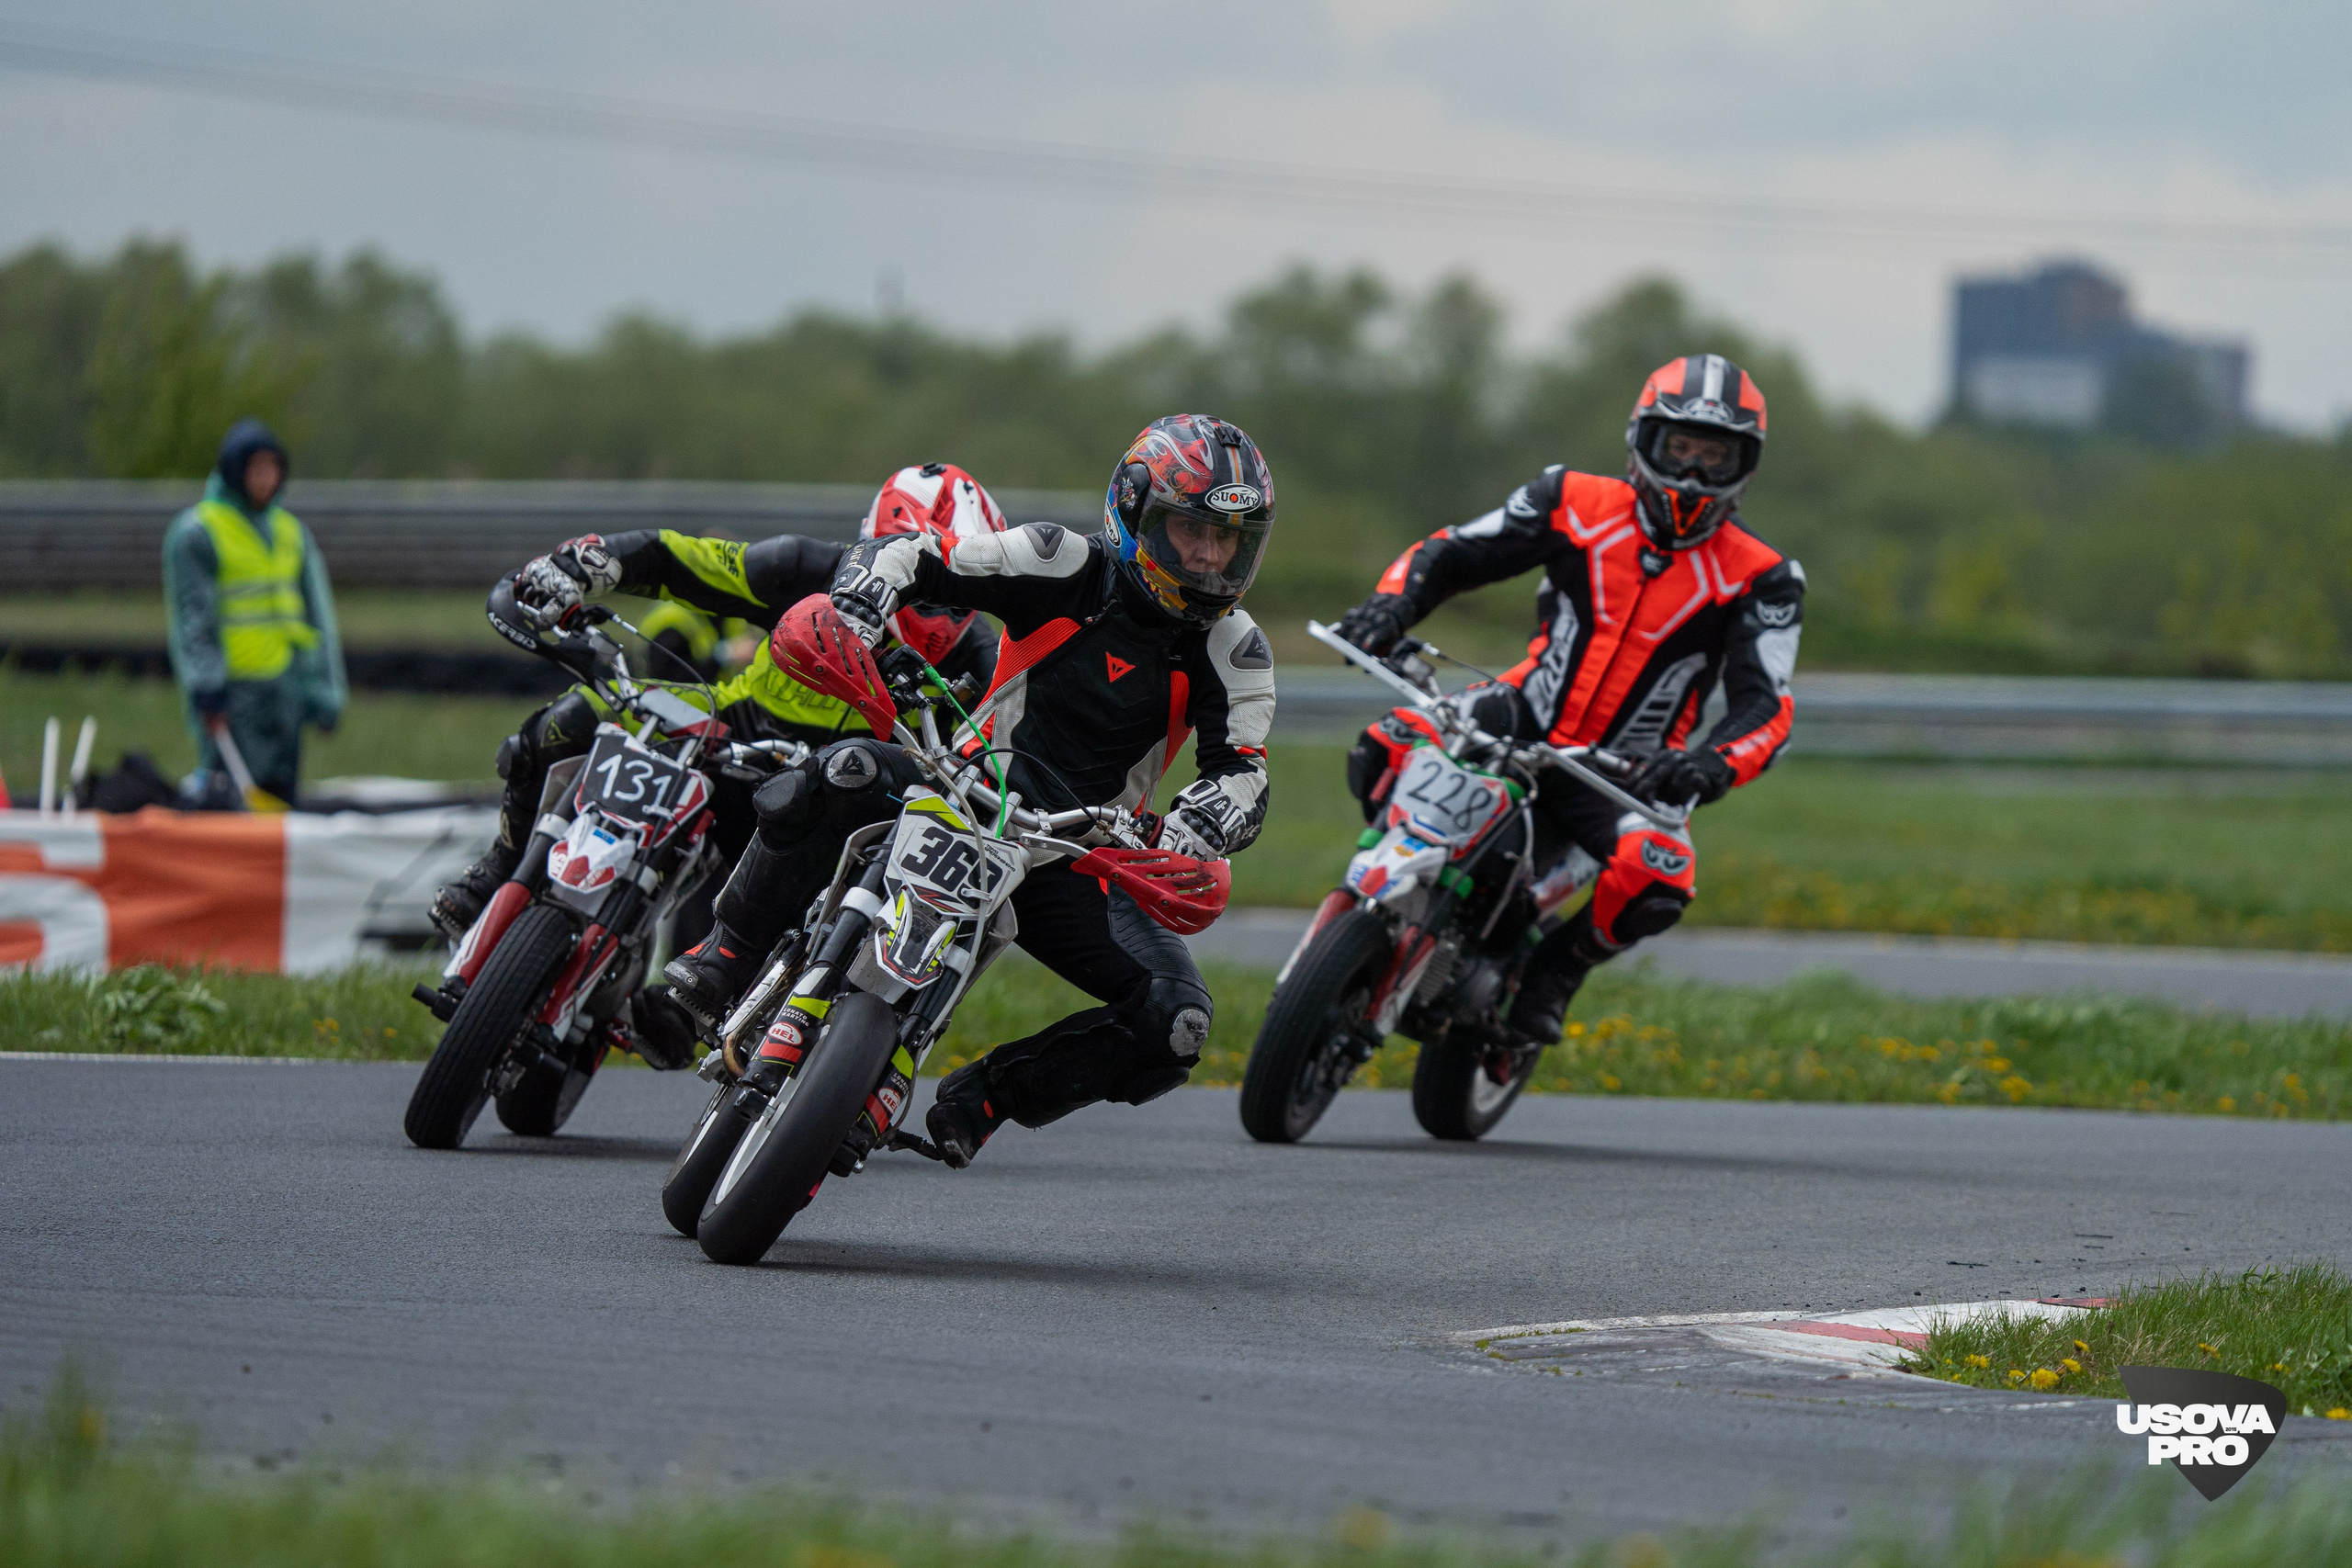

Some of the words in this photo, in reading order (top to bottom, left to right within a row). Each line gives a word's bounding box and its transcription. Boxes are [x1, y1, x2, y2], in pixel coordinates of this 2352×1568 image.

[1213, 491, 1258, 507] SUOMY
[488, 612, 537, 649] ACERBIS
[596, 754, 672, 807] 131
[1407, 761, 1492, 830] 228
[900, 826, 1003, 909] 369
[782, 1012, 809, 1027] KARTING
[784, 1007, 808, 1020] LONATO
[772, 1028, 795, 1043] HEL
